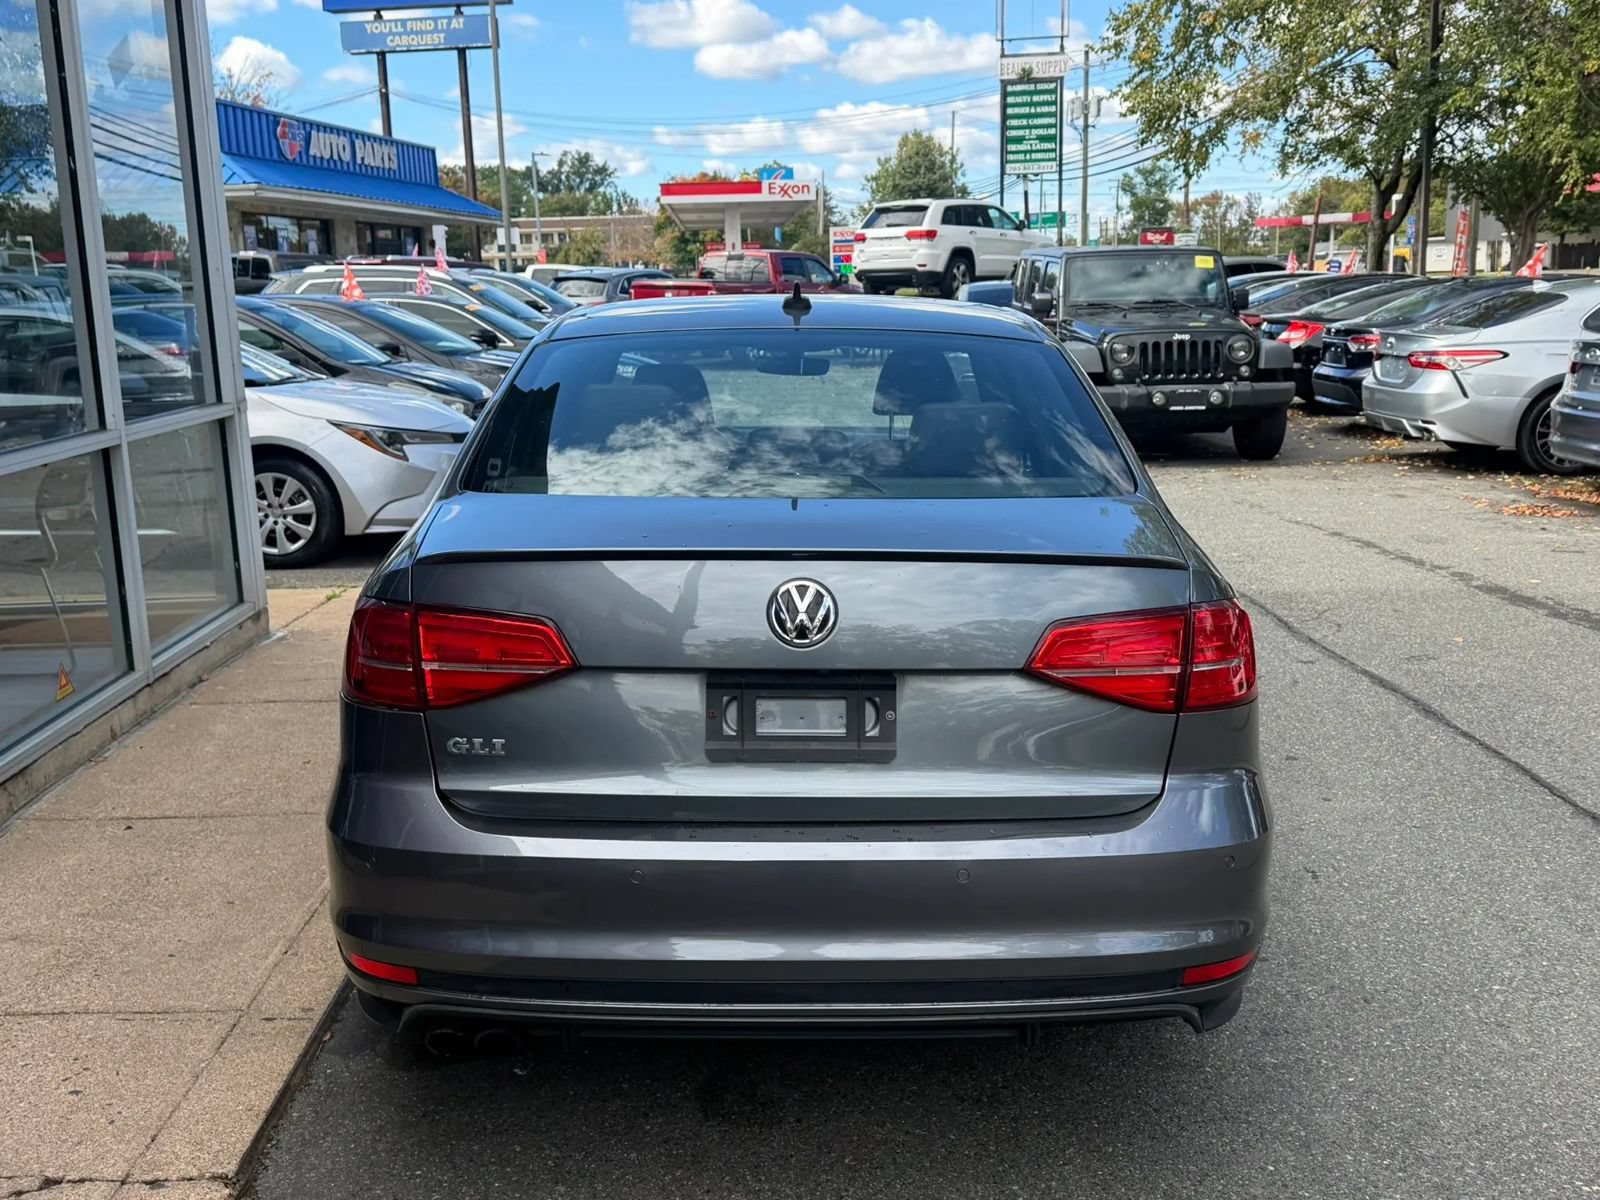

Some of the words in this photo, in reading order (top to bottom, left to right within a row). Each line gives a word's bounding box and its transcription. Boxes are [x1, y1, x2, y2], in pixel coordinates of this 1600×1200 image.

[365, 22, 404, 34] YOU'LL
[407, 20, 435, 31] FIND
[438, 18, 448, 29] IT
[451, 18, 465, 29] AT
[386, 33, 446, 47] CARQUEST
[1036, 59, 1068, 75] SUPPLY
[1006, 96, 1031, 104] BEAUTY
[1032, 94, 1056, 102] SUPPLY
[1006, 118, 1028, 126] CHECK
[1028, 116, 1056, 125] CASHING
[1006, 129, 1030, 137] CHOICE
[1031, 127, 1056, 135] DOLLAR
[309, 129, 351, 162] AUTO
[354, 138, 397, 171] PARTS
[1007, 143, 1031, 151] TIENDA
[1031, 142, 1056, 150] LATINA
[768, 182, 810, 199] Exxon
[1172, 332, 1191, 340] Jeep
[446, 736, 506, 755] GLI
